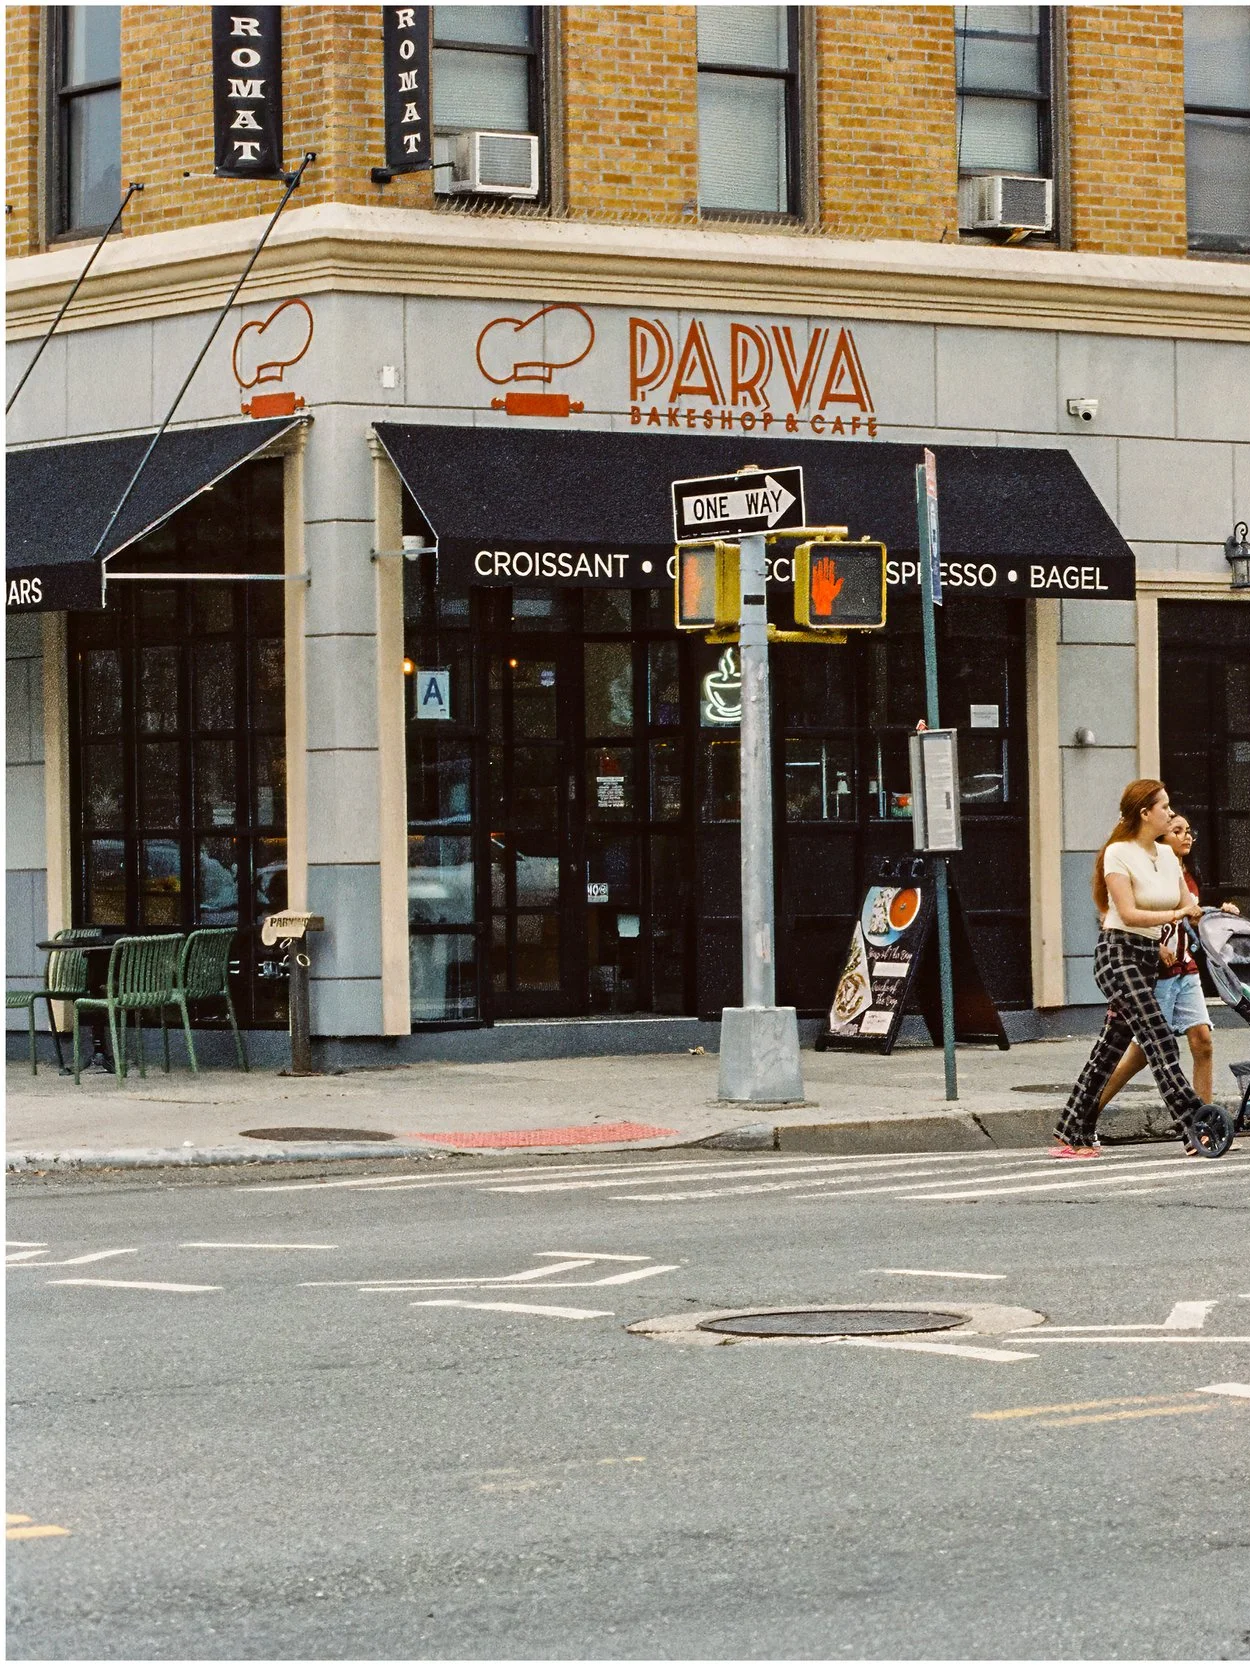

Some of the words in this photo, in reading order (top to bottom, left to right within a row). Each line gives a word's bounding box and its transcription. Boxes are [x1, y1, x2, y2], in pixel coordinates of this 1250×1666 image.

[227, 16, 266, 160] ROMAT
[395, 8, 422, 154] ROMAT
[629, 317, 875, 413] PARVA
[630, 405, 774, 431] BAKESHOP
[785, 413, 799, 433] &
[810, 414, 878, 437] CAFE
[693, 496, 729, 521] ONE
[745, 489, 783, 515] WAY
[474, 550, 630, 578] CROISSANT
[885, 561, 997, 587] SPESSO
[1030, 565, 1109, 590] BAGEL
[7, 577, 43, 605] ARS
[422, 677, 444, 706] A
